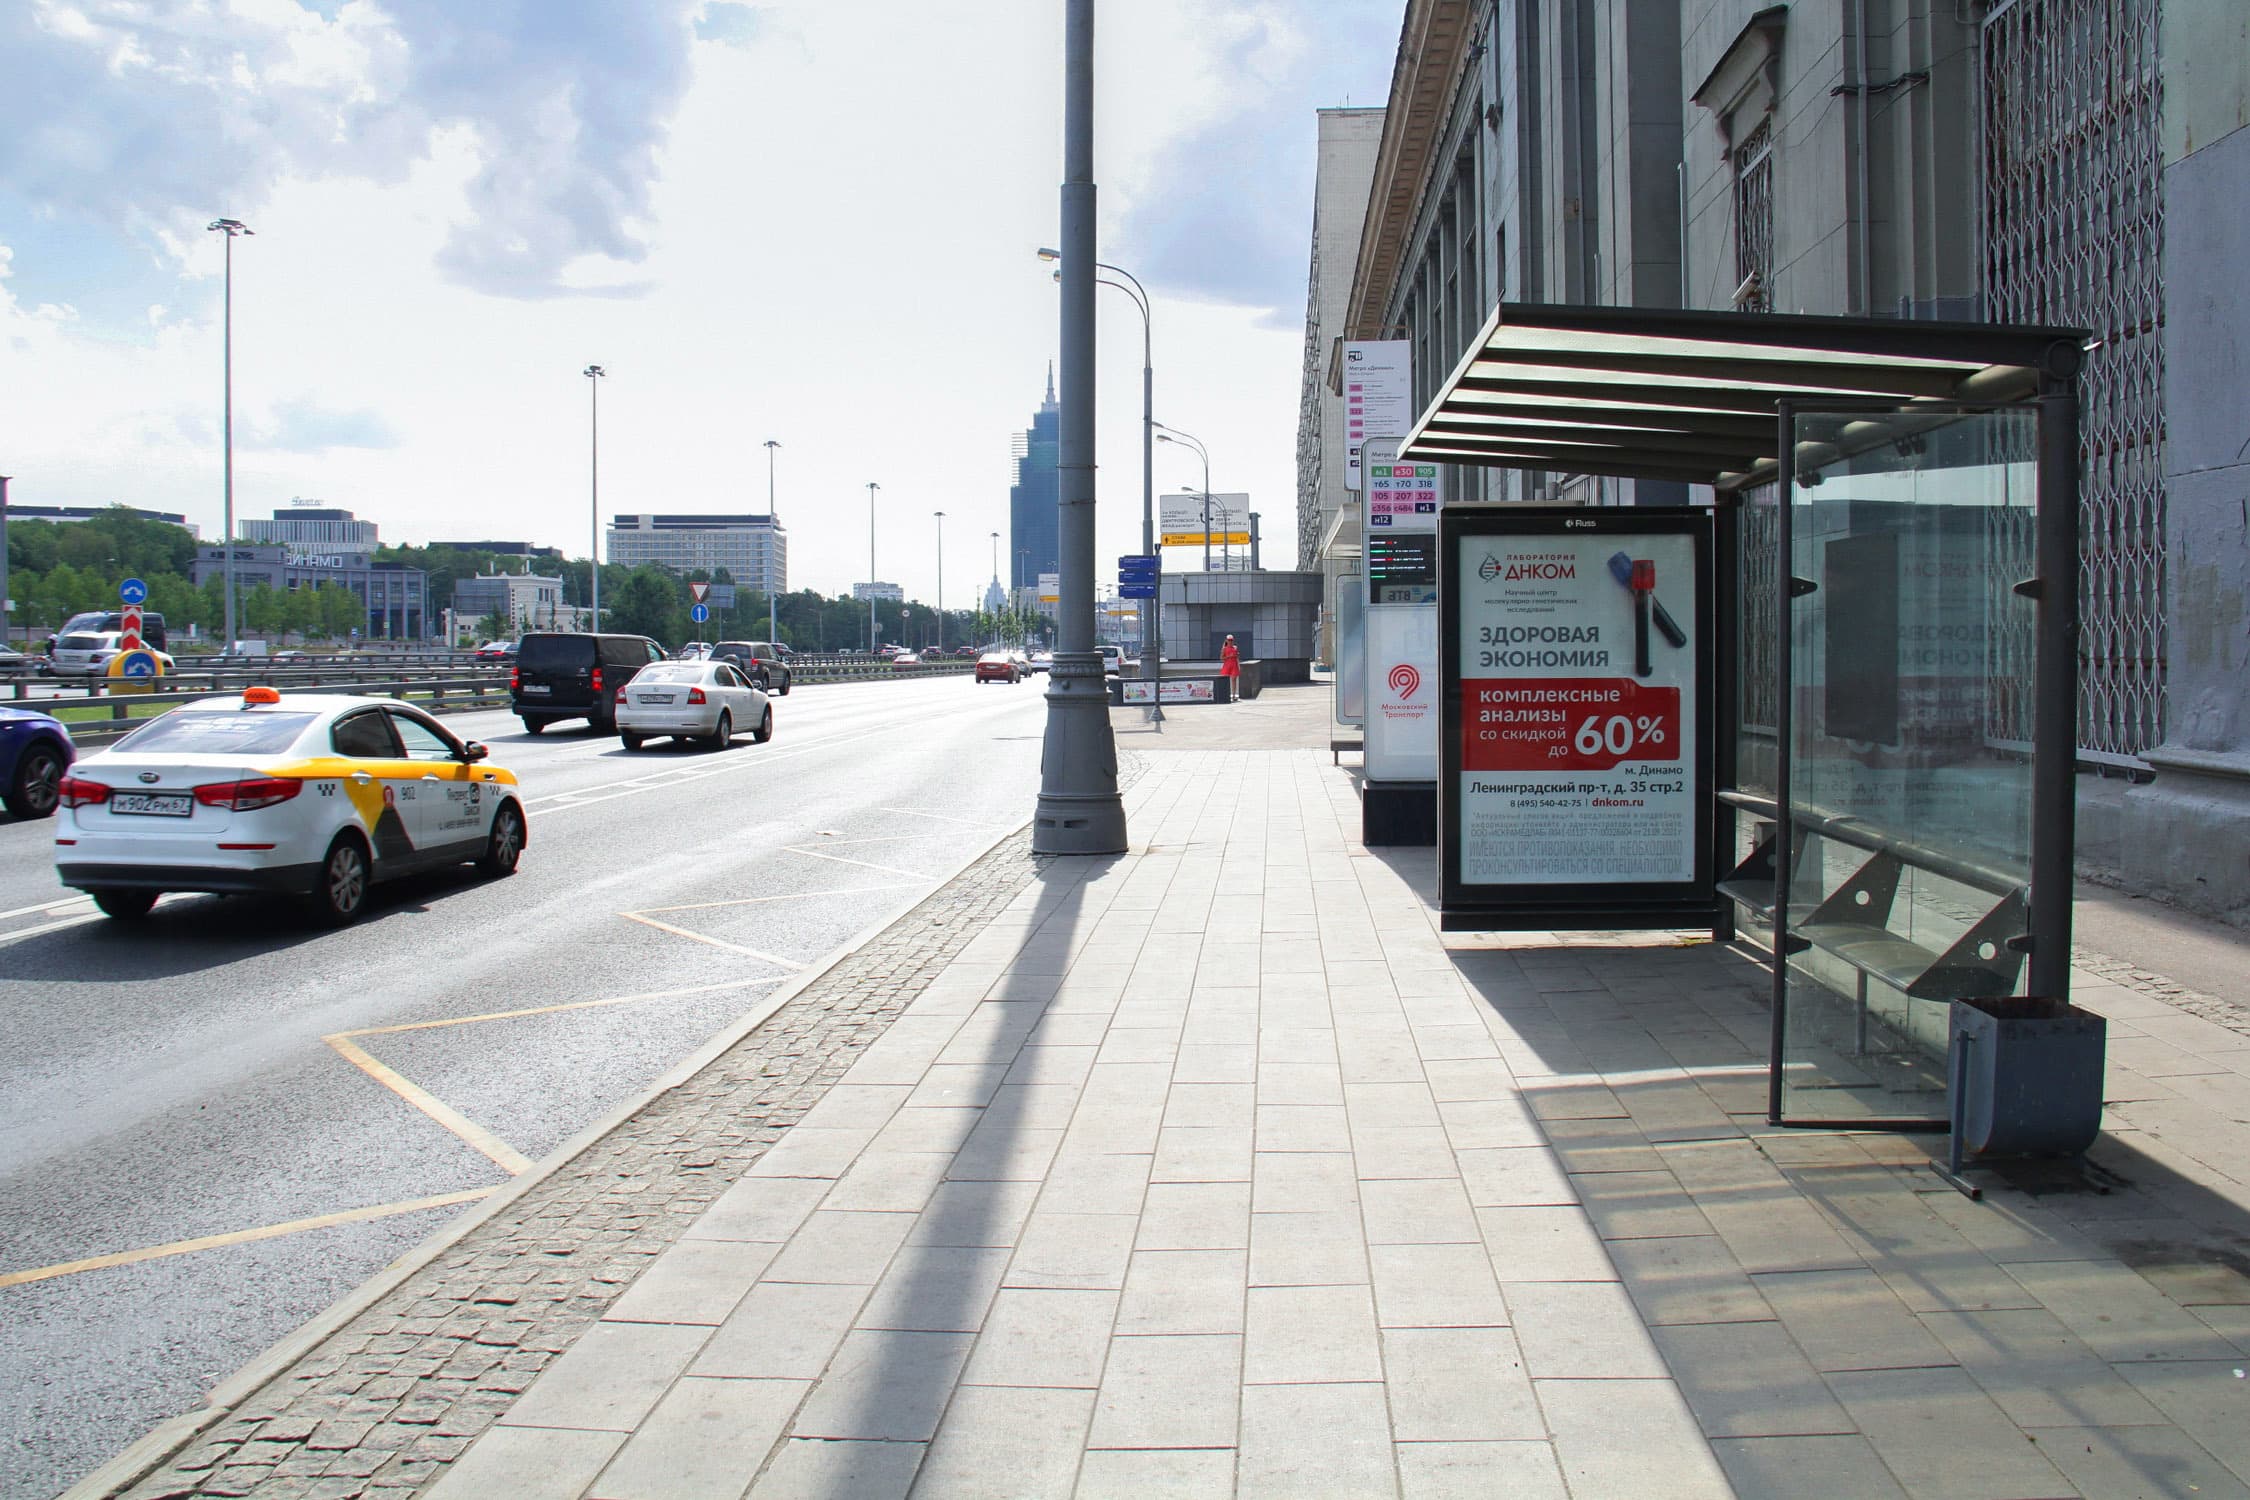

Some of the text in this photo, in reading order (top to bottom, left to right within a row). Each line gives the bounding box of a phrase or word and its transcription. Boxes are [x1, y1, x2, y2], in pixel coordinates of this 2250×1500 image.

[1417, 467, 1433, 475] 905
[1374, 480, 1433, 488] т65 т70 318
[1374, 492, 1433, 500] 105 207 322
[1504, 563, 1576, 581] ДНКОМ
[1479, 626, 1600, 647] ЗДОРОВАЯ
[1479, 650, 1609, 667] ЭКОНОМИЯ
[1479, 689, 1621, 703] комплексные
[1381, 703, 1428, 711] Московский
[1385, 711, 1425, 719] Транспорт
[1479, 709, 1567, 722] анализы
[1479, 727, 1567, 742] со скидкой
[1574, 715, 1665, 755] 60%
[1548, 745, 1568, 758] до
[1624, 765, 1684, 776] м. Динамо
[401, 786, 416, 800] 902
[1470, 781, 1684, 796] Ленинградский пр-т, д. 35 стр.2
[1510, 799, 1582, 809] 8 (495) 540-42-75
[1591, 797, 1645, 808] dnkom.ru
